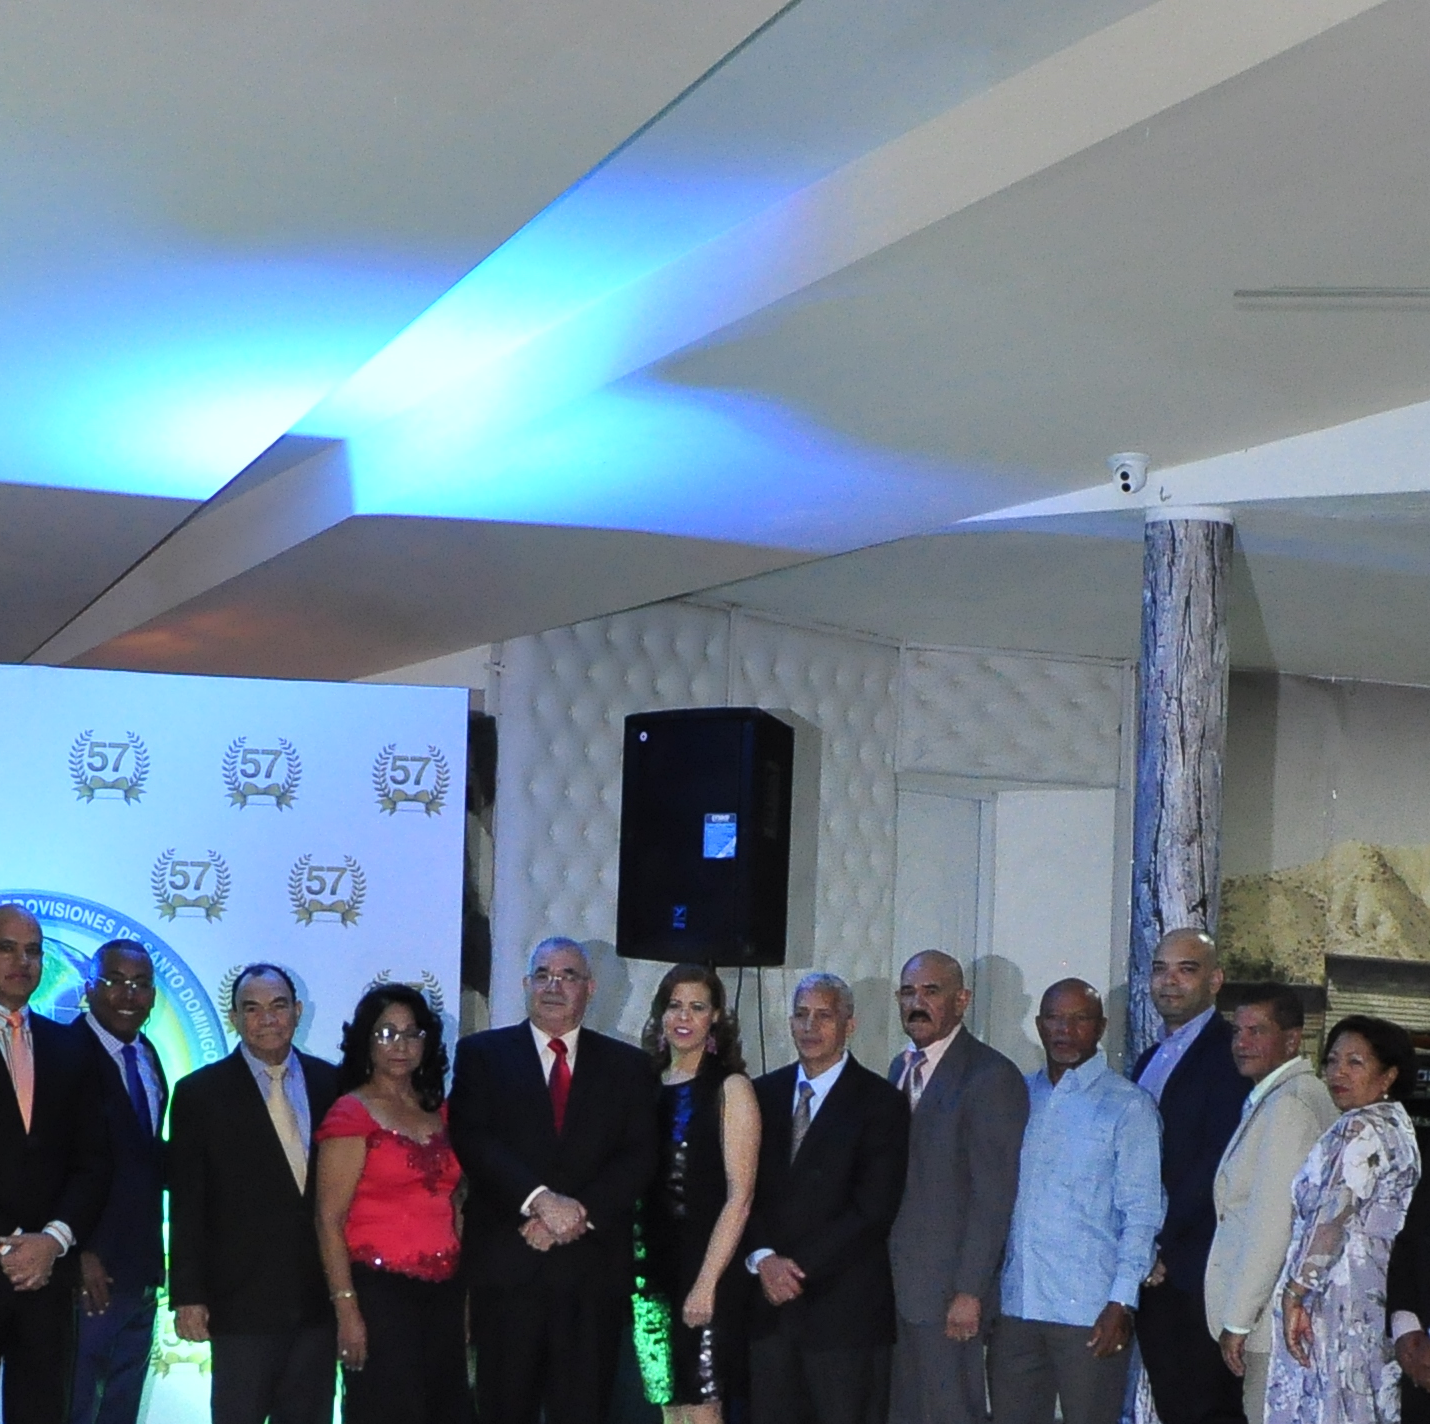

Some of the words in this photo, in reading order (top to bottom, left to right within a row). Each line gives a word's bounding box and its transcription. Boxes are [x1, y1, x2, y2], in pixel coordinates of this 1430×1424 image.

[86, 741, 131, 773] 57
[239, 748, 283, 779] 57
[389, 755, 432, 786] 57
[168, 860, 212, 892] 57
[305, 866, 348, 897] 57
[142, 942, 185, 988] SANTO
[179, 988, 219, 1061] DOMINGO
